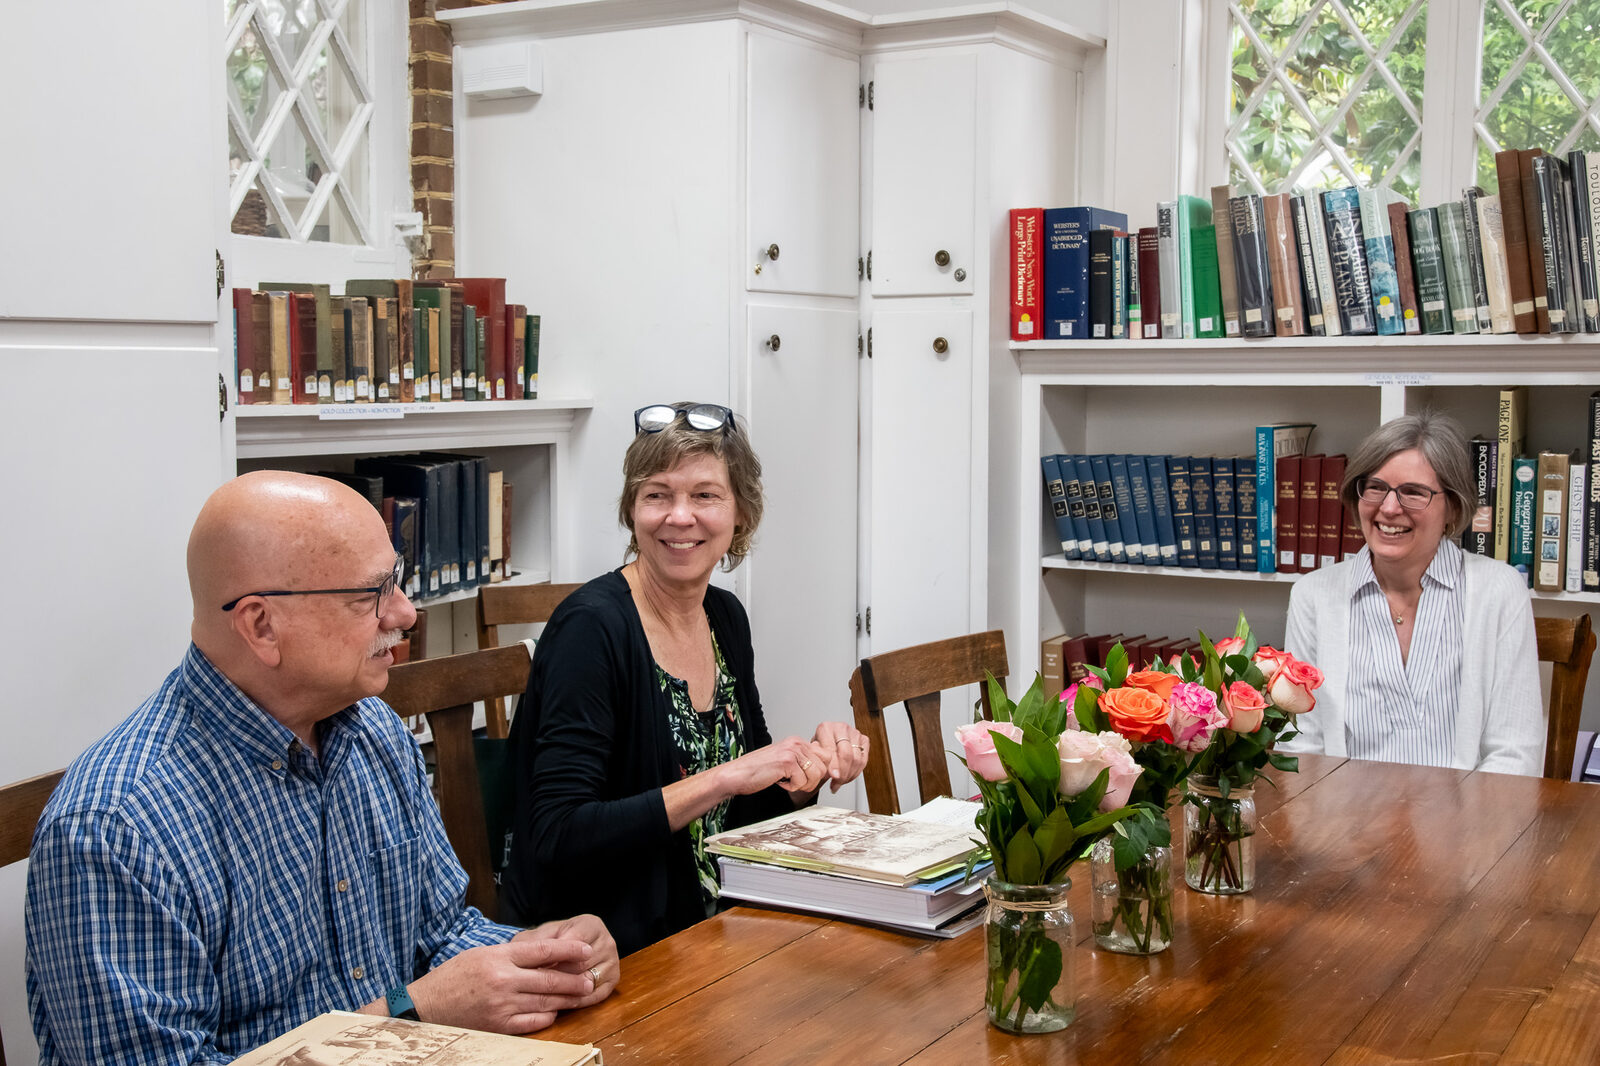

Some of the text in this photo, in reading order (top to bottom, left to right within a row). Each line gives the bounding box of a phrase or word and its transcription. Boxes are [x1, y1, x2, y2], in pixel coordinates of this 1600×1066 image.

[1159, 208, 1171, 238] SCIENCE
[1233, 200, 1247, 236] BIRDS
[1015, 216, 1026, 307] Large Print Dictionary
[1026, 216, 1035, 307] Webster's New World
[1052, 242, 1081, 250] DICTIONARY
[1542, 235, 1552, 250] Bob
[1333, 250, 1354, 307] PLANTS
[1350, 246, 1371, 304] GARDEN
[1544, 251, 1556, 289] Timberlake
[1499, 400, 1511, 444] PAGE ONE
[1478, 445, 1488, 497] ENCYCLOPEDIA
[1590, 463, 1600, 503] WORLDS
[1513, 491, 1523, 526] Dictionary
[1521, 491, 1534, 555] Geographical
[1571, 476, 1583, 543] GHOST SHIP
